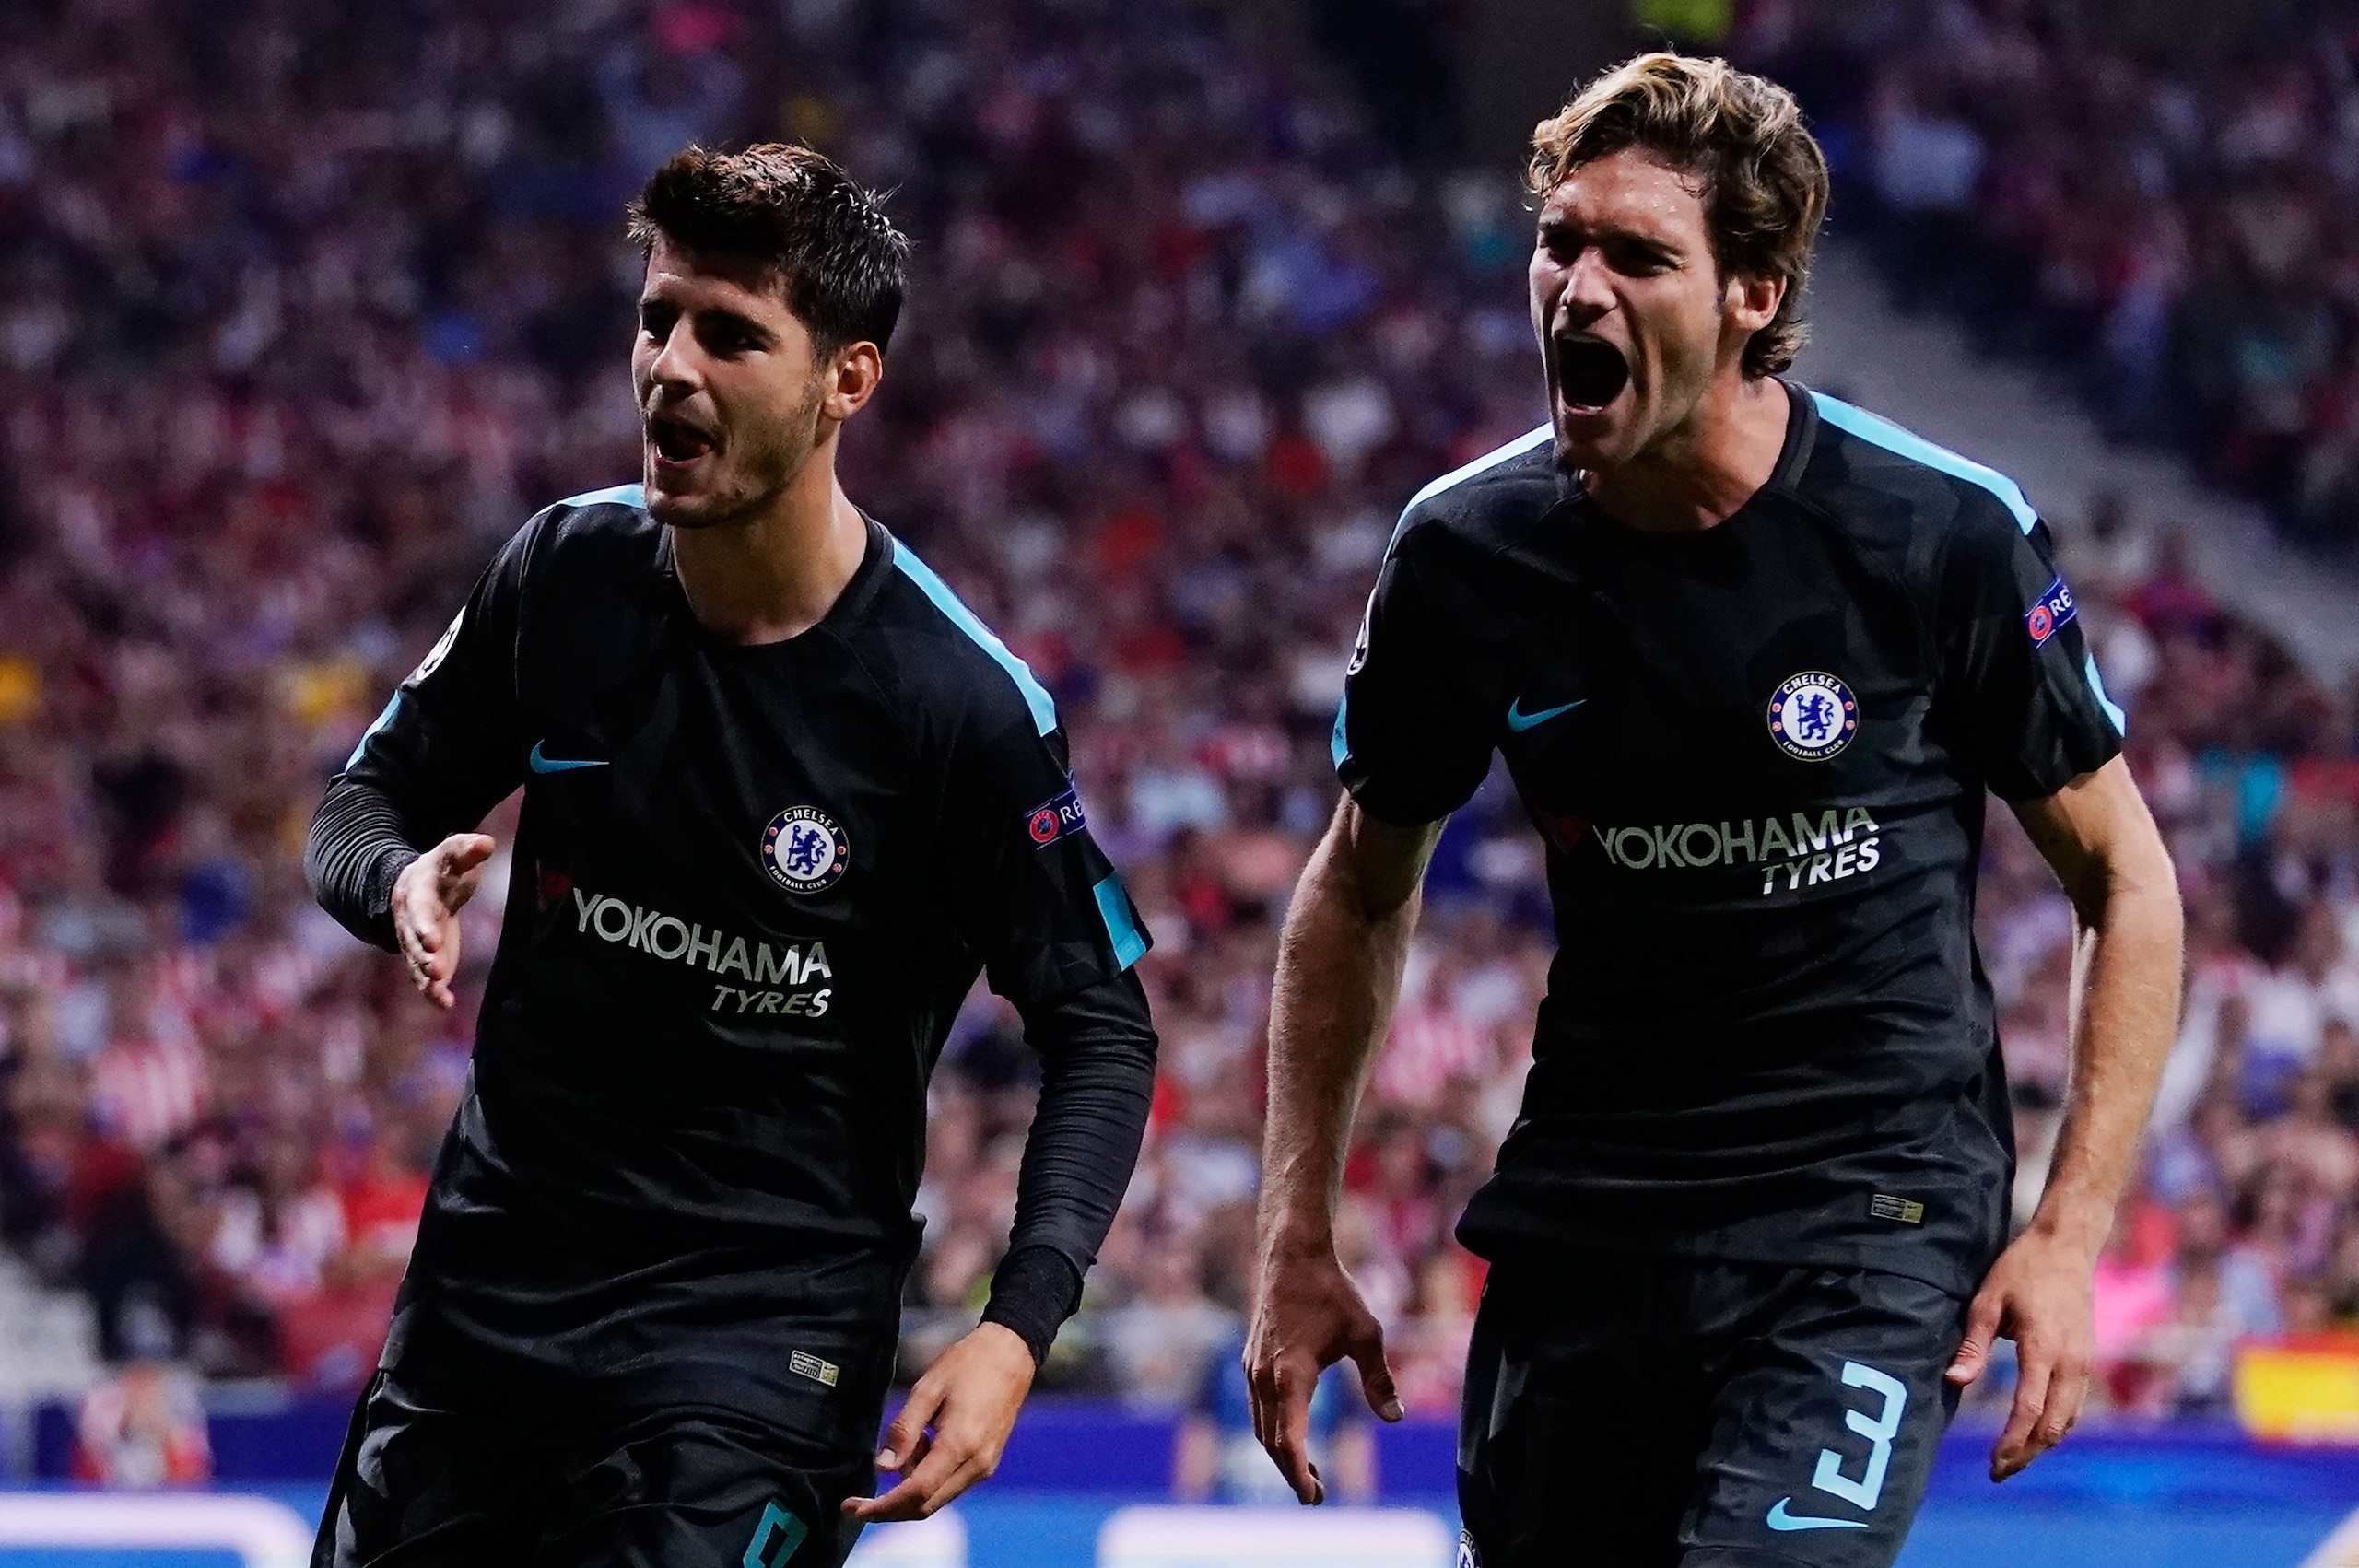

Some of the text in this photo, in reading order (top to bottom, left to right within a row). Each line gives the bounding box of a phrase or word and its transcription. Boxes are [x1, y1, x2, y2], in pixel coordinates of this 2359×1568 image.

[1782, 674, 1841, 695] CHELSEA
[1783, 739, 1844, 756] FOOTBALL CLUB
[784, 809, 839, 836] CHELSEA
[1592, 807, 1880, 869] YOKOHAMA
[769, 866, 827, 889] FOOTBALL CLUB
[1761, 837, 1880, 895] TYRES
[573, 887, 832, 984] YOKOHAMA
[711, 985, 832, 1017] TYRES
[1812, 1361, 1907, 1511] 3
